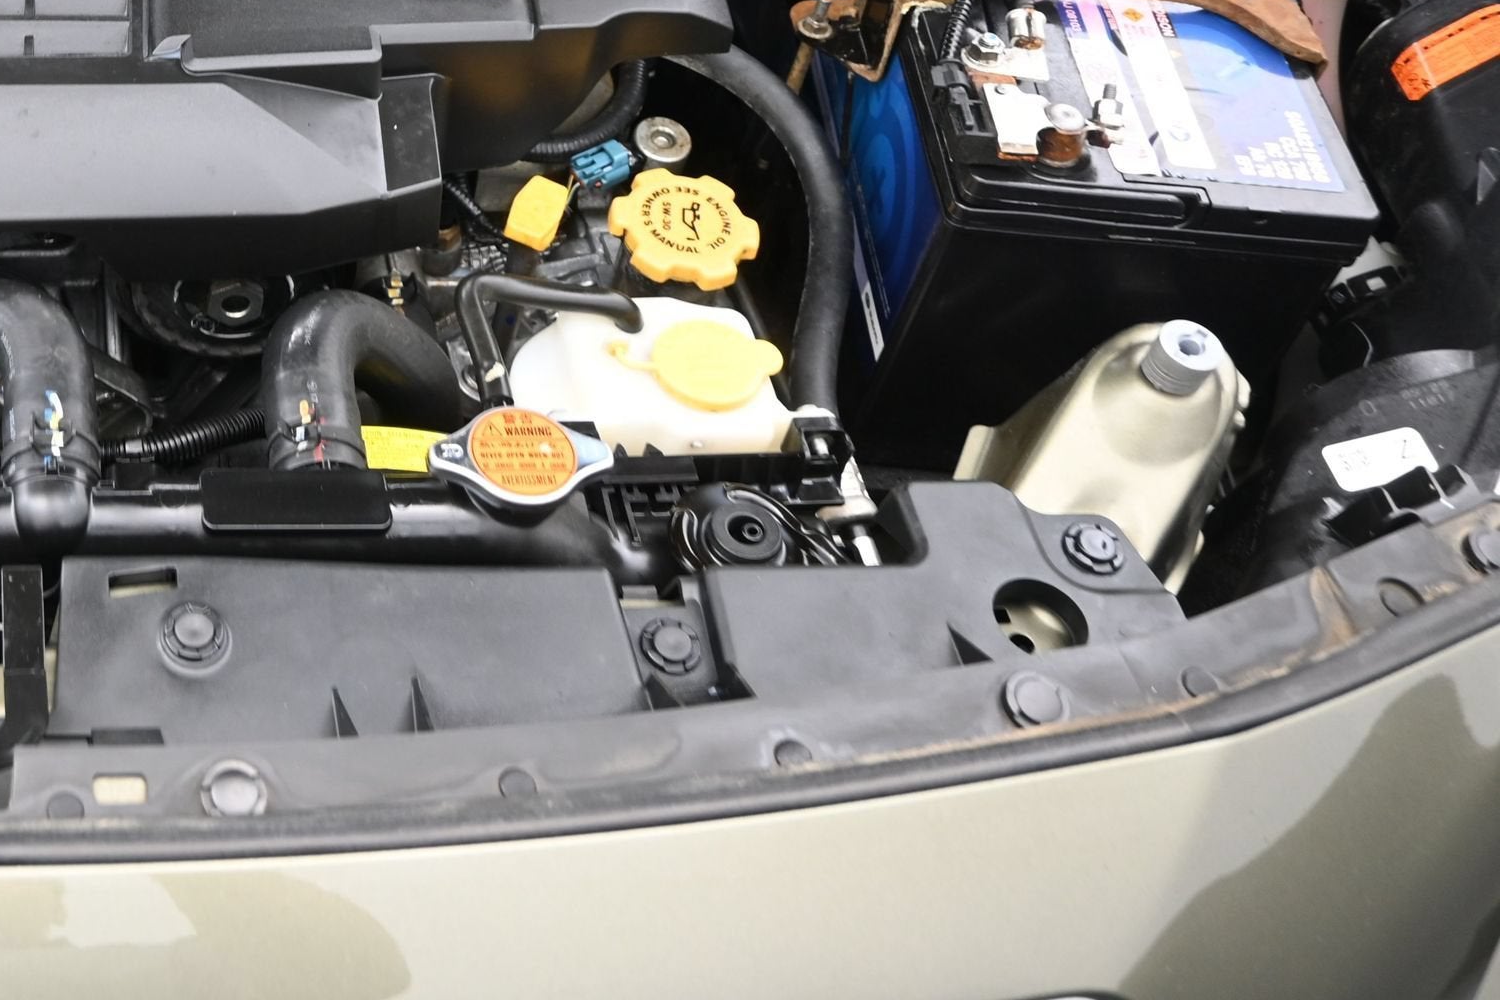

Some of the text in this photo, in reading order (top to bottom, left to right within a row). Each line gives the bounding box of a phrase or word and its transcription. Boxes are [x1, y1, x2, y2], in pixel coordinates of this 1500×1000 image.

[674, 186, 700, 196] SEE
[705, 196, 732, 250] ENGINE OIL
[650, 229, 702, 254] MANUAL
[504, 425, 552, 436] WARNING
